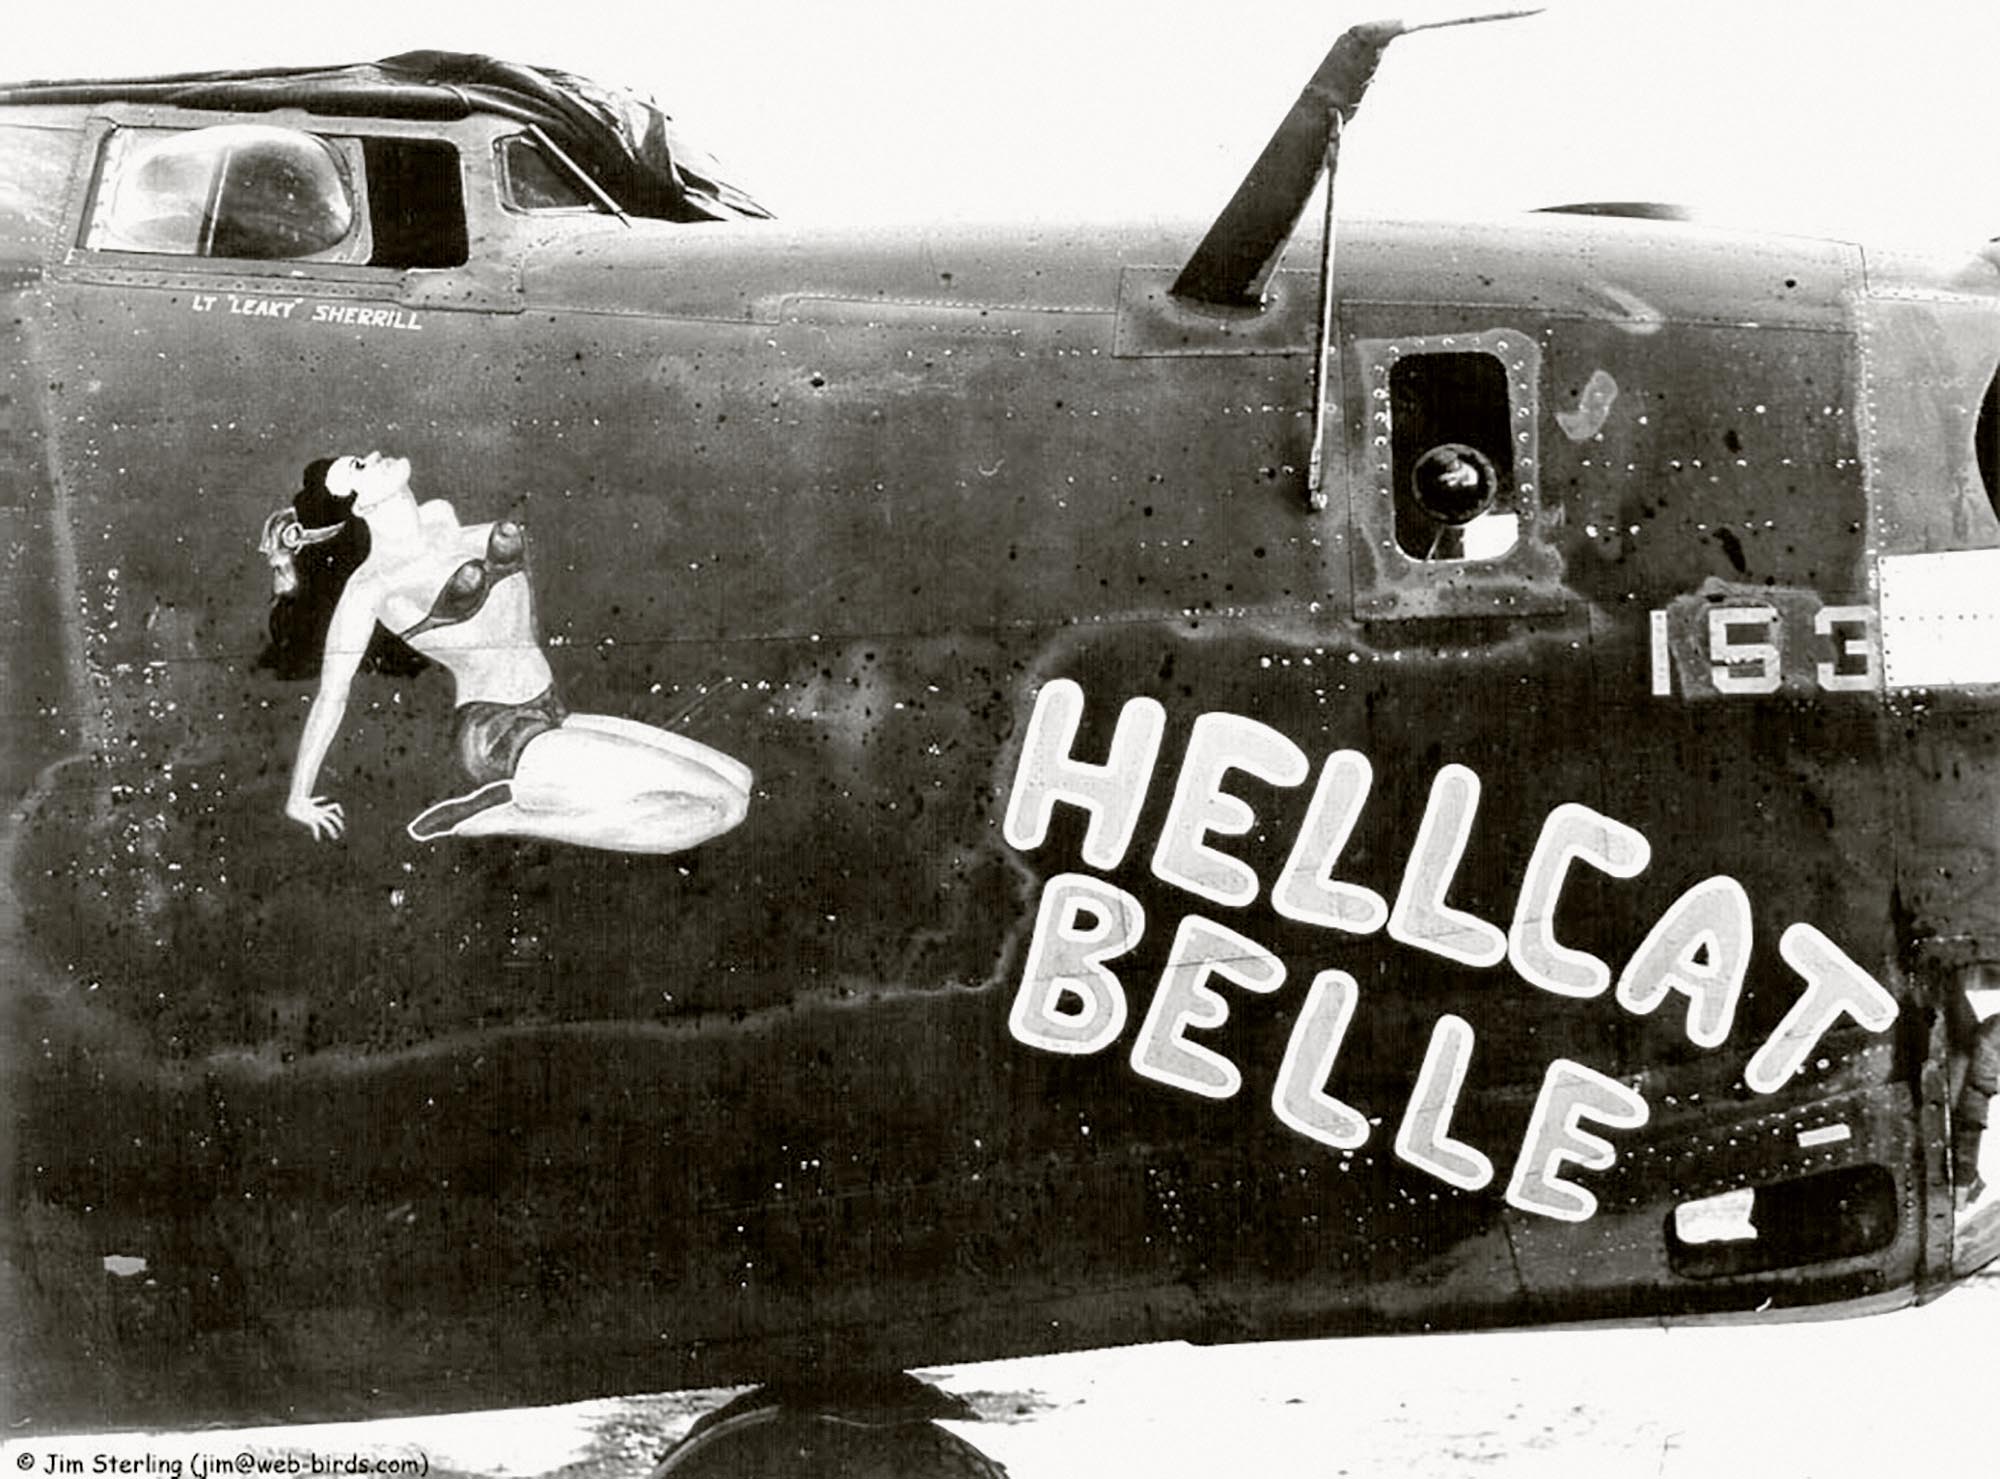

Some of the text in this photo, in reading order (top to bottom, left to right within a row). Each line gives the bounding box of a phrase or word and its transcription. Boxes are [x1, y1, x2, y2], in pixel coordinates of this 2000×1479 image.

[192, 294, 218, 312] LT
[312, 304, 423, 330] SHERRILL
[1650, 604, 1881, 695] 153
[1003, 678, 1899, 1094] HELLCAT
[1009, 873, 1650, 1222] BELLE
